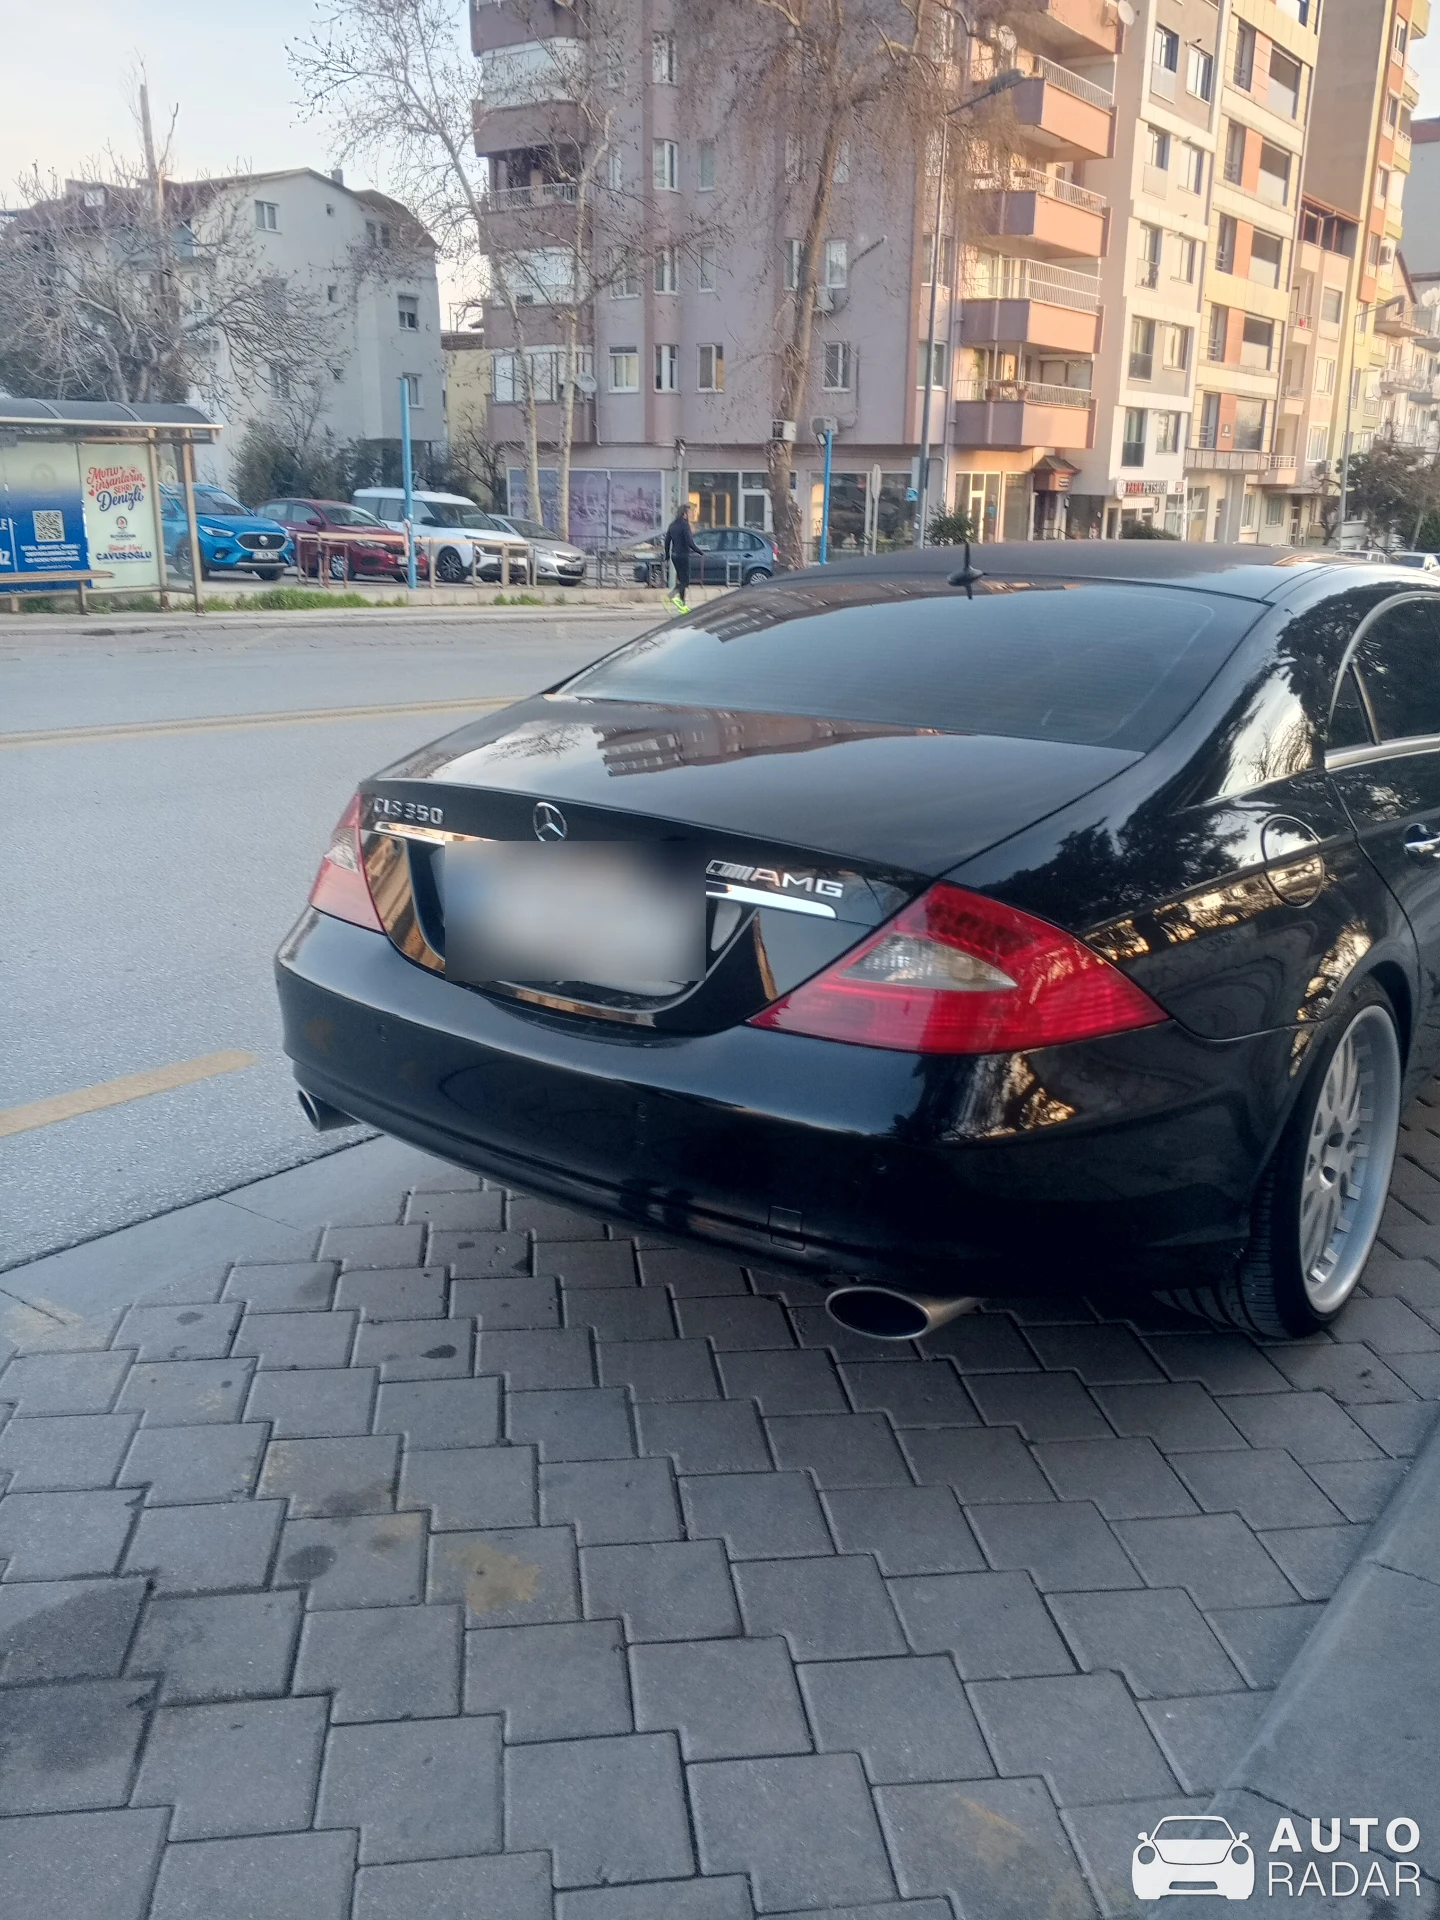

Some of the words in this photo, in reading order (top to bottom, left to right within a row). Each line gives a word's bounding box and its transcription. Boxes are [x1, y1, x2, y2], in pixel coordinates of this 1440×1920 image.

[96, 484, 144, 512] Denizli
[373, 797, 403, 818] CLS
[403, 802, 444, 825] 350
[750, 867, 844, 899] AMG
